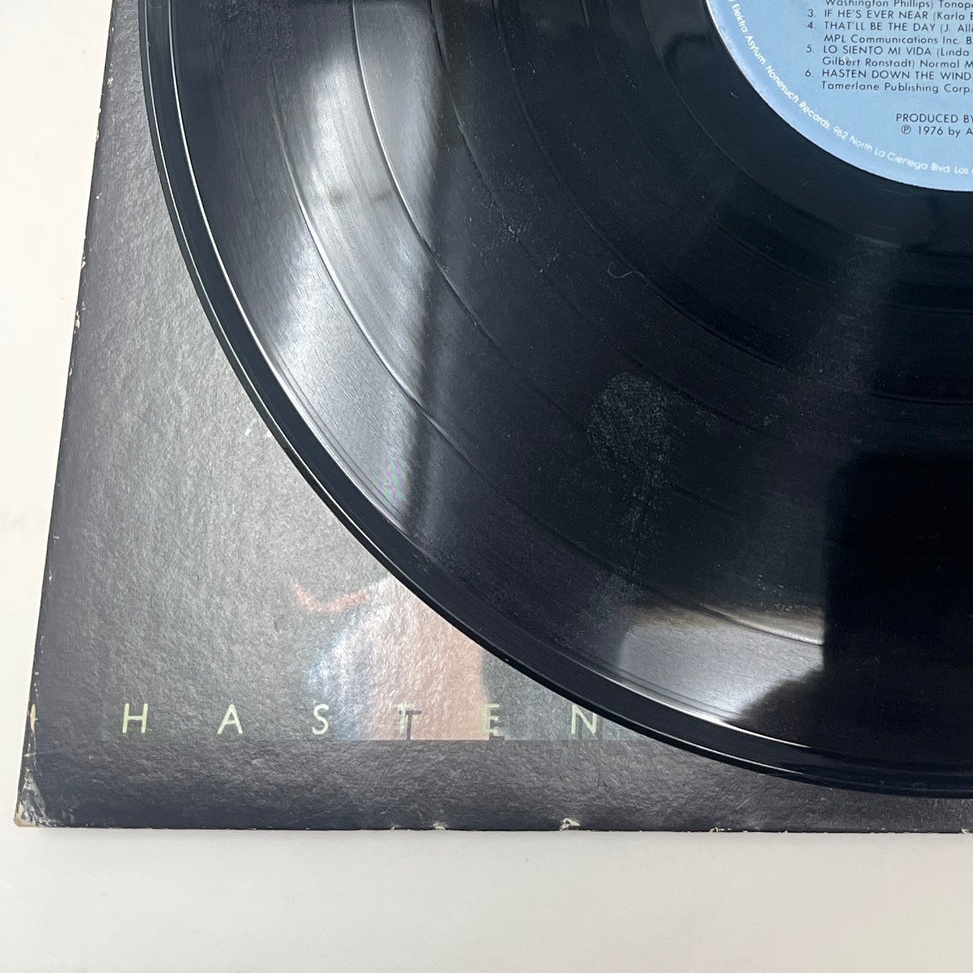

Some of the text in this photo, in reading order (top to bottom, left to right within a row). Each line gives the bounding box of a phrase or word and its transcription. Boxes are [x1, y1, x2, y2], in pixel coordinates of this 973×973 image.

[824, 10, 832, 18] IF
[838, 9, 862, 19] HE'S
[867, 10, 894, 19] EVER
[899, 11, 928, 20] NEAR
[933, 11, 965, 21] (Karla
[824, 21, 865, 31] THAT'LL
[870, 22, 882, 31] BE
[888, 22, 907, 31] THE
[913, 23, 936, 32] DAY
[824, 34, 846, 43] MPL
[851, 34, 938, 44] Communications
[824, 45, 838, 53] LO
[842, 45, 884, 55] SIENTO
[888, 46, 901, 55] MI
[906, 47, 932, 56] VIDA
[936, 48, 970, 57] (Linda
[822, 56, 861, 66] Gilbert
[865, 58, 915, 69] Ronstadt)
[919, 59, 960, 69] Normal
[822, 69, 867, 78] HASTEN
[872, 70, 910, 79] DOWN
[915, 71, 935, 80] THE
[940, 72, 972, 81] WIND
[821, 81, 880, 91] Tamerlane
[884, 82, 939, 94] Publishing
[896, 113, 958, 124] PRODUCED
[917, 126, 944, 136] 1976
[948, 126, 961, 138] by
[122, 702, 598, 735] HASTEN
